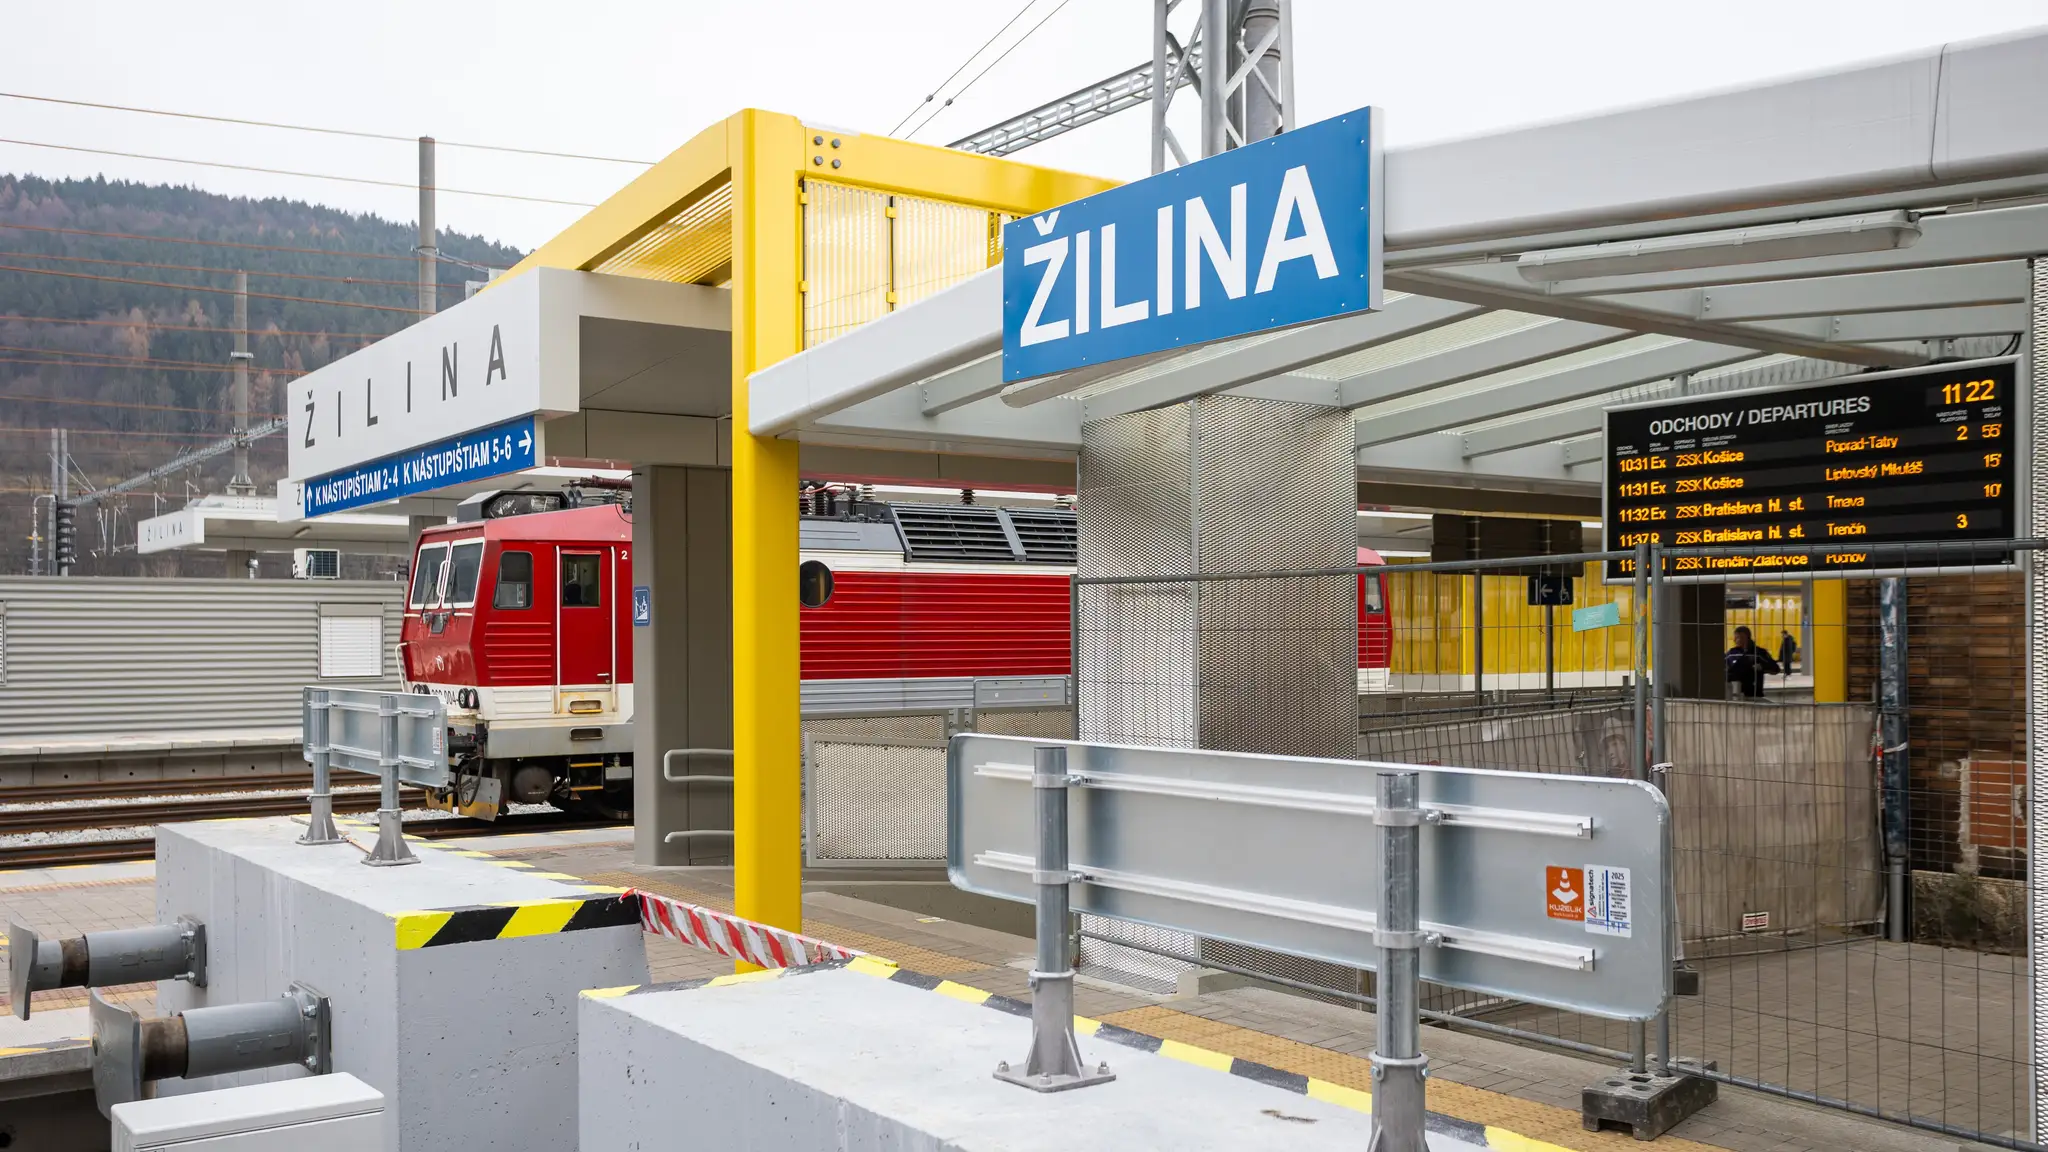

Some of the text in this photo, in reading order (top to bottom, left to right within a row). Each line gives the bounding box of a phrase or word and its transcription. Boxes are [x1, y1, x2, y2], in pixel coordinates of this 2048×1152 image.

[1020, 164, 1339, 347] ŽILINA
[304, 324, 507, 448] ŽILINA
[1650, 396, 1871, 436] ODCHODY / DEPARTURES
[1650, 456, 1667, 470] Ex
[1675, 453, 1703, 468] ZSSK
[1703, 450, 1745, 465] Košice
[1825, 436, 1899, 454] Poprad-Tatry
[1956, 425, 1968, 441] 2
[322, 470, 382, 503] NÁSTUPIŠTIAM
[382, 471, 399, 490] 2-4
[412, 443, 490, 481] NÁSTUPIŠTIAM
[492, 434, 512, 463] 5-6
[1650, 481, 1667, 496] Ex
[1675, 479, 1703, 494] ZSSK
[1703, 476, 1745, 491] Košice
[1825, 465, 1878, 482] Liptovský
[1880, 460, 1924, 477] Mikuláš
[1650, 507, 1667, 521] Ex
[1675, 505, 1703, 520] ZSSK
[1703, 501, 1763, 517] Bratislava
[1768, 498, 1782, 513] hl.
[1788, 496, 1805, 511] st.
[1675, 531, 1703, 546] ZSSK
[1703, 527, 1763, 543] Bratislava
[1768, 525, 1782, 540] hl.
[1788, 523, 1805, 538] st.
[1826, 522, 1867, 537] Trenčín
[1956, 513, 1969, 529] 3
[621, 550, 628, 560] 2
[1675, 557, 1703, 571] ZSSK
[1611, 872, 1625, 880] 2025
